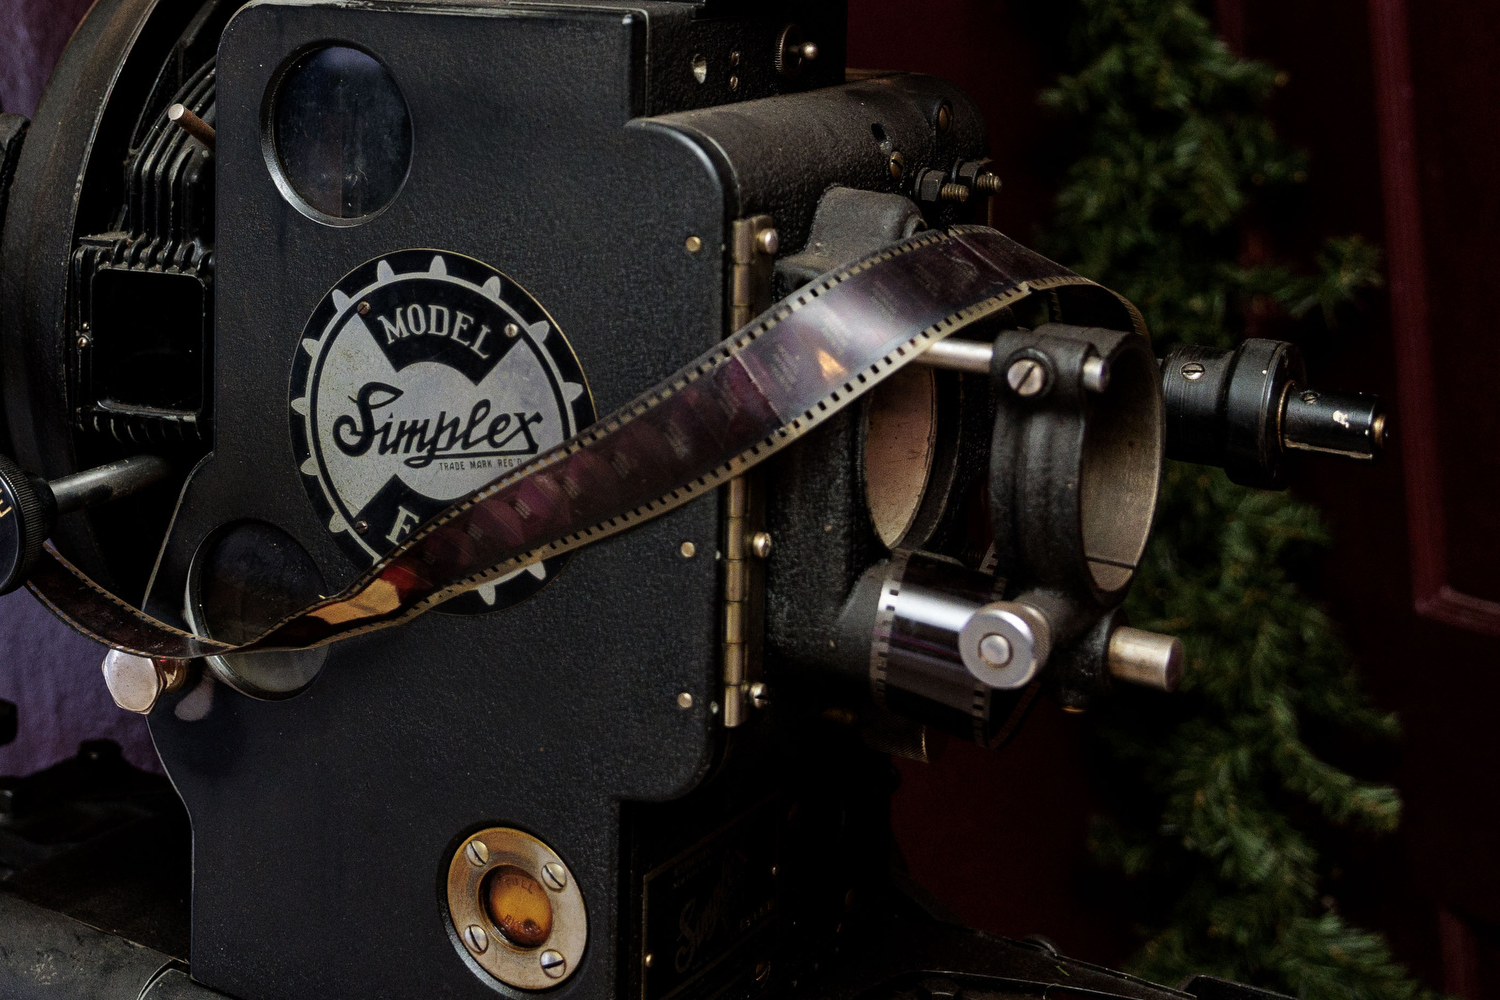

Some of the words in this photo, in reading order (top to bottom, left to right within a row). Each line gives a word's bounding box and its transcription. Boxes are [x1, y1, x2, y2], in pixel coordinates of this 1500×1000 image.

[376, 303, 491, 360] MODEL
[332, 381, 543, 469] Simplex
[439, 461, 465, 471] TRADE
[469, 459, 493, 470] MARK
